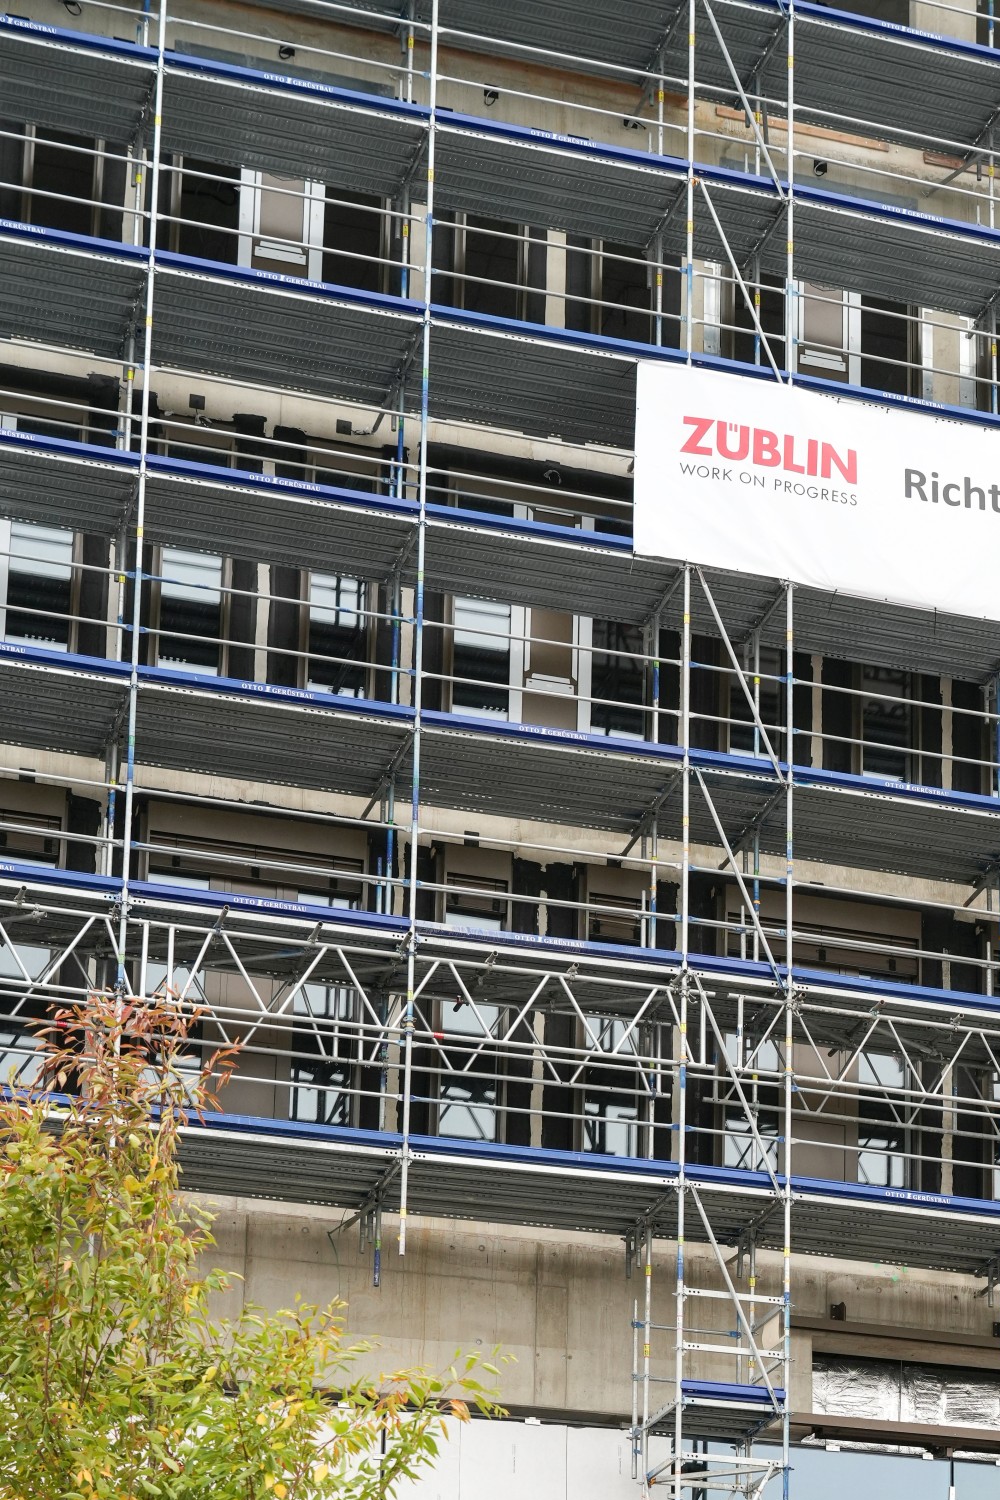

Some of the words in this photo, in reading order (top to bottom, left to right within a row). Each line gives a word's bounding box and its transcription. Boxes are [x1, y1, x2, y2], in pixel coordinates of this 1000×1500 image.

[882, 22, 899, 30] OTTO
[264, 74, 284, 82] OTTO
[531, 130, 550, 139] OTTO
[882, 205, 900, 213] OTTO
[257, 272, 277, 280] OTTO
[680, 416, 858, 485] ZÜBLIN
[679, 462, 732, 481] WORK
[739, 472, 765, 488] ON
[774, 479, 858, 506] PROGRESS
